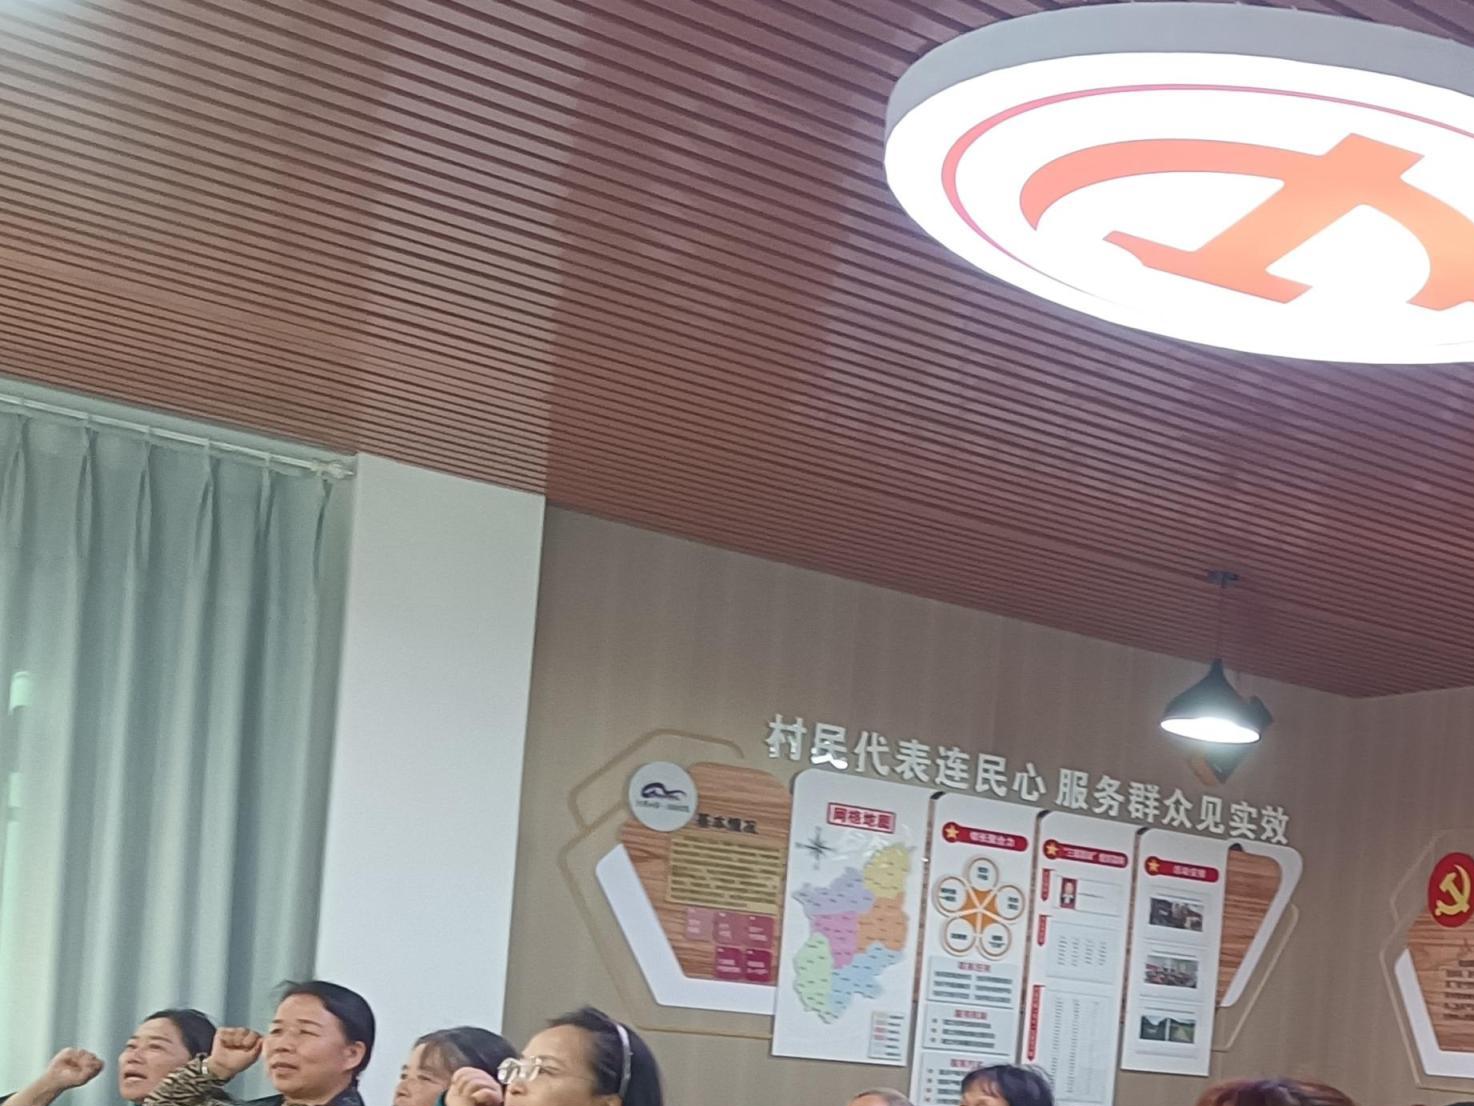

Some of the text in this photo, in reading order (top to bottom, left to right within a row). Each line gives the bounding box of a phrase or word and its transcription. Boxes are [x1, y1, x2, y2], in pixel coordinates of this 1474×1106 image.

[766, 714, 1290, 845] 村民代表连民心 服务群众见实效
